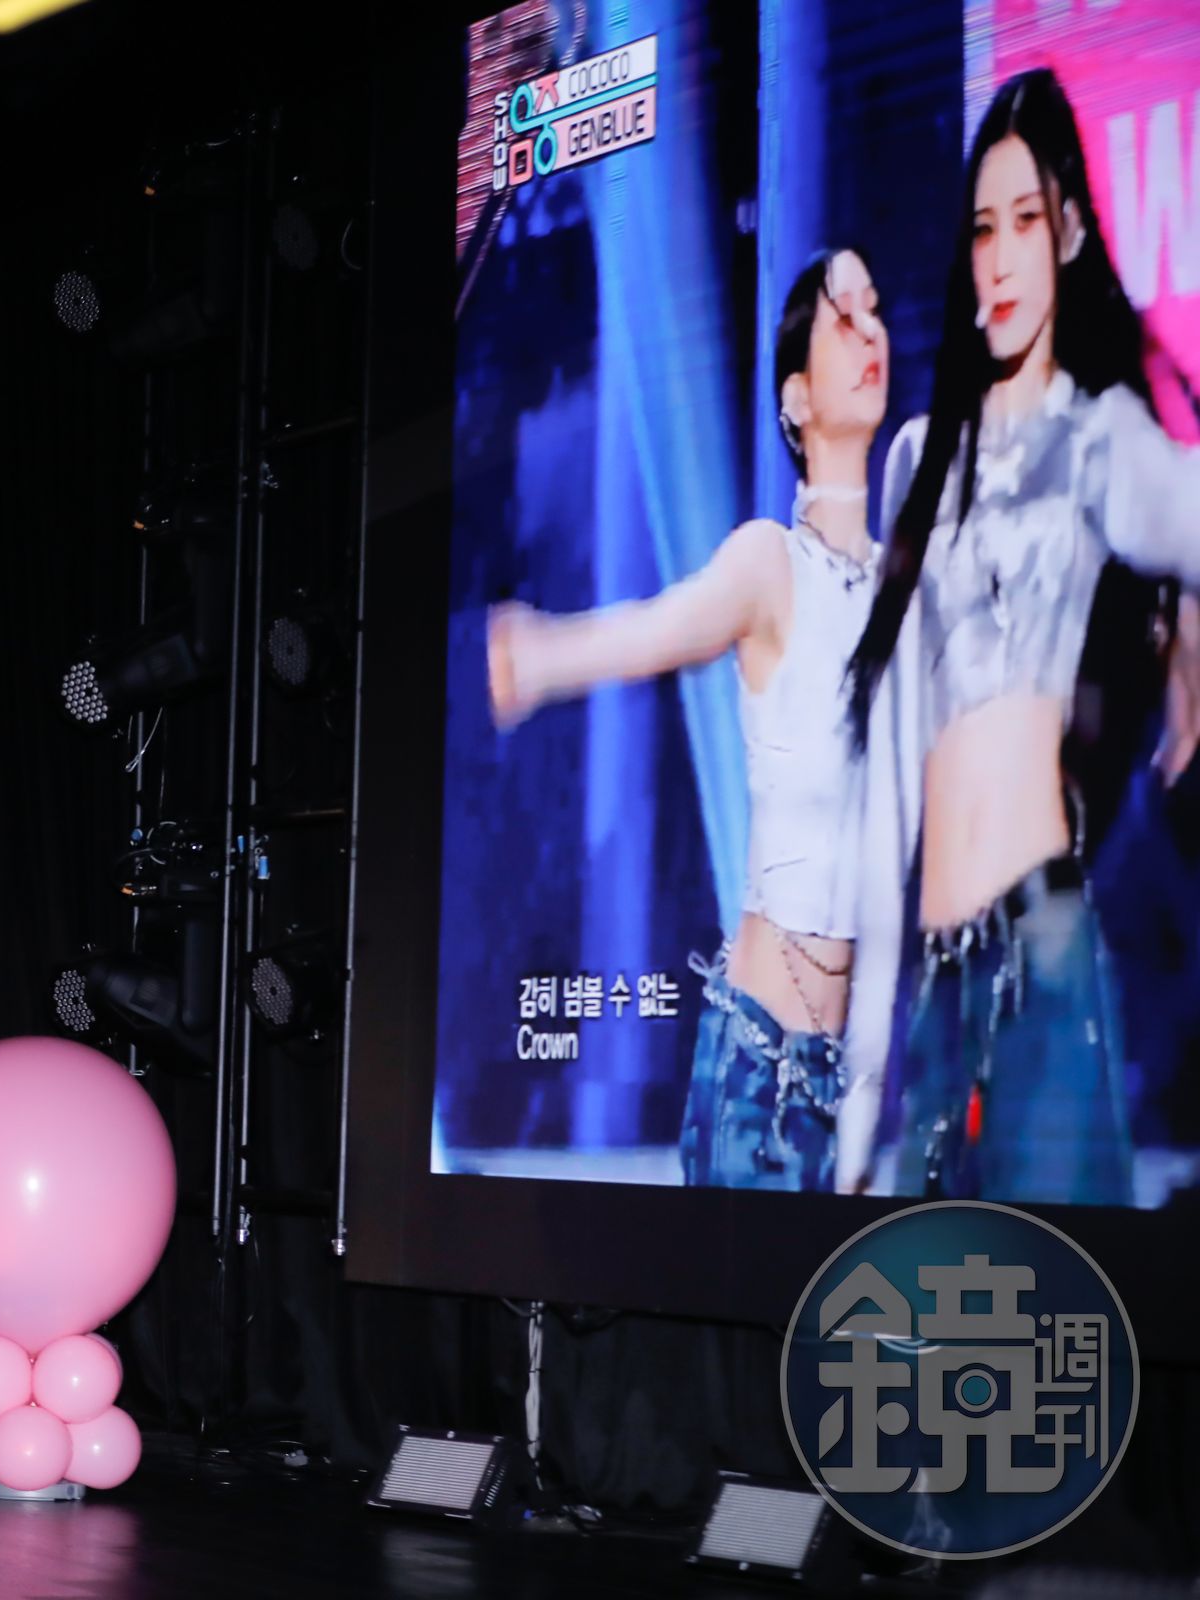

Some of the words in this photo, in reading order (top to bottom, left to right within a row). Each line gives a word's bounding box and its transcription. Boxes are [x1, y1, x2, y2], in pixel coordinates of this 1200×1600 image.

[568, 51, 629, 98] COCOCO
[568, 99, 645, 157] GENBLUE
[519, 976, 557, 1018] 감히
[563, 975, 604, 1018] 넘볼
[608, 974, 631, 1018] 수
[637, 973, 680, 1017] 없는
[517, 1024, 579, 1060] Crown
